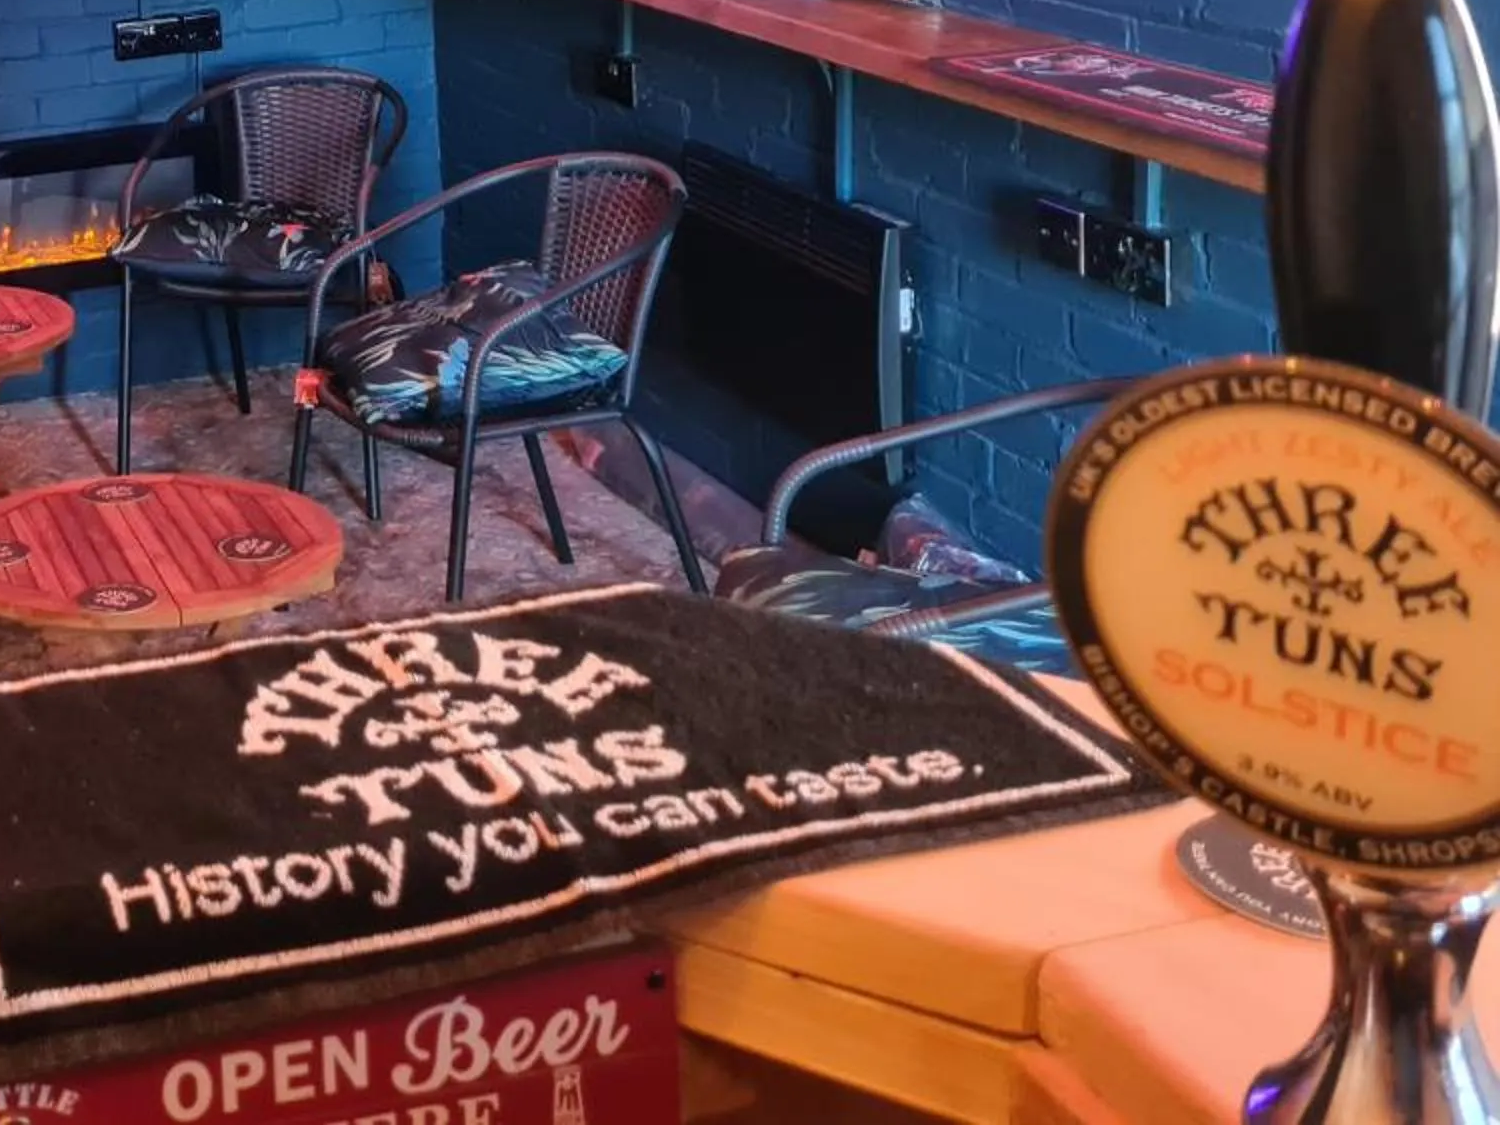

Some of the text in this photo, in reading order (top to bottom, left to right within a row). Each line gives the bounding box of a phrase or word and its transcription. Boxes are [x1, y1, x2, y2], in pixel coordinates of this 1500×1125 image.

[1109, 378, 1219, 446] OLDEST
[1229, 375, 1417, 438] LICENSED
[1423, 425, 1500, 500] BRE
[1178, 475, 1472, 620] THREE
[237, 631, 651, 755] THREE
[1192, 589, 1442, 702] TUNS
[300, 725, 687, 825] TUNS
[1152, 646, 1482, 781] SOLSTICE
[100, 749, 984, 932] History you can taste.
[1310, 780, 1374, 814] ABV
[1358, 825, 1500, 867] SHROPS
[161, 994, 630, 1123] OPEN Beer
